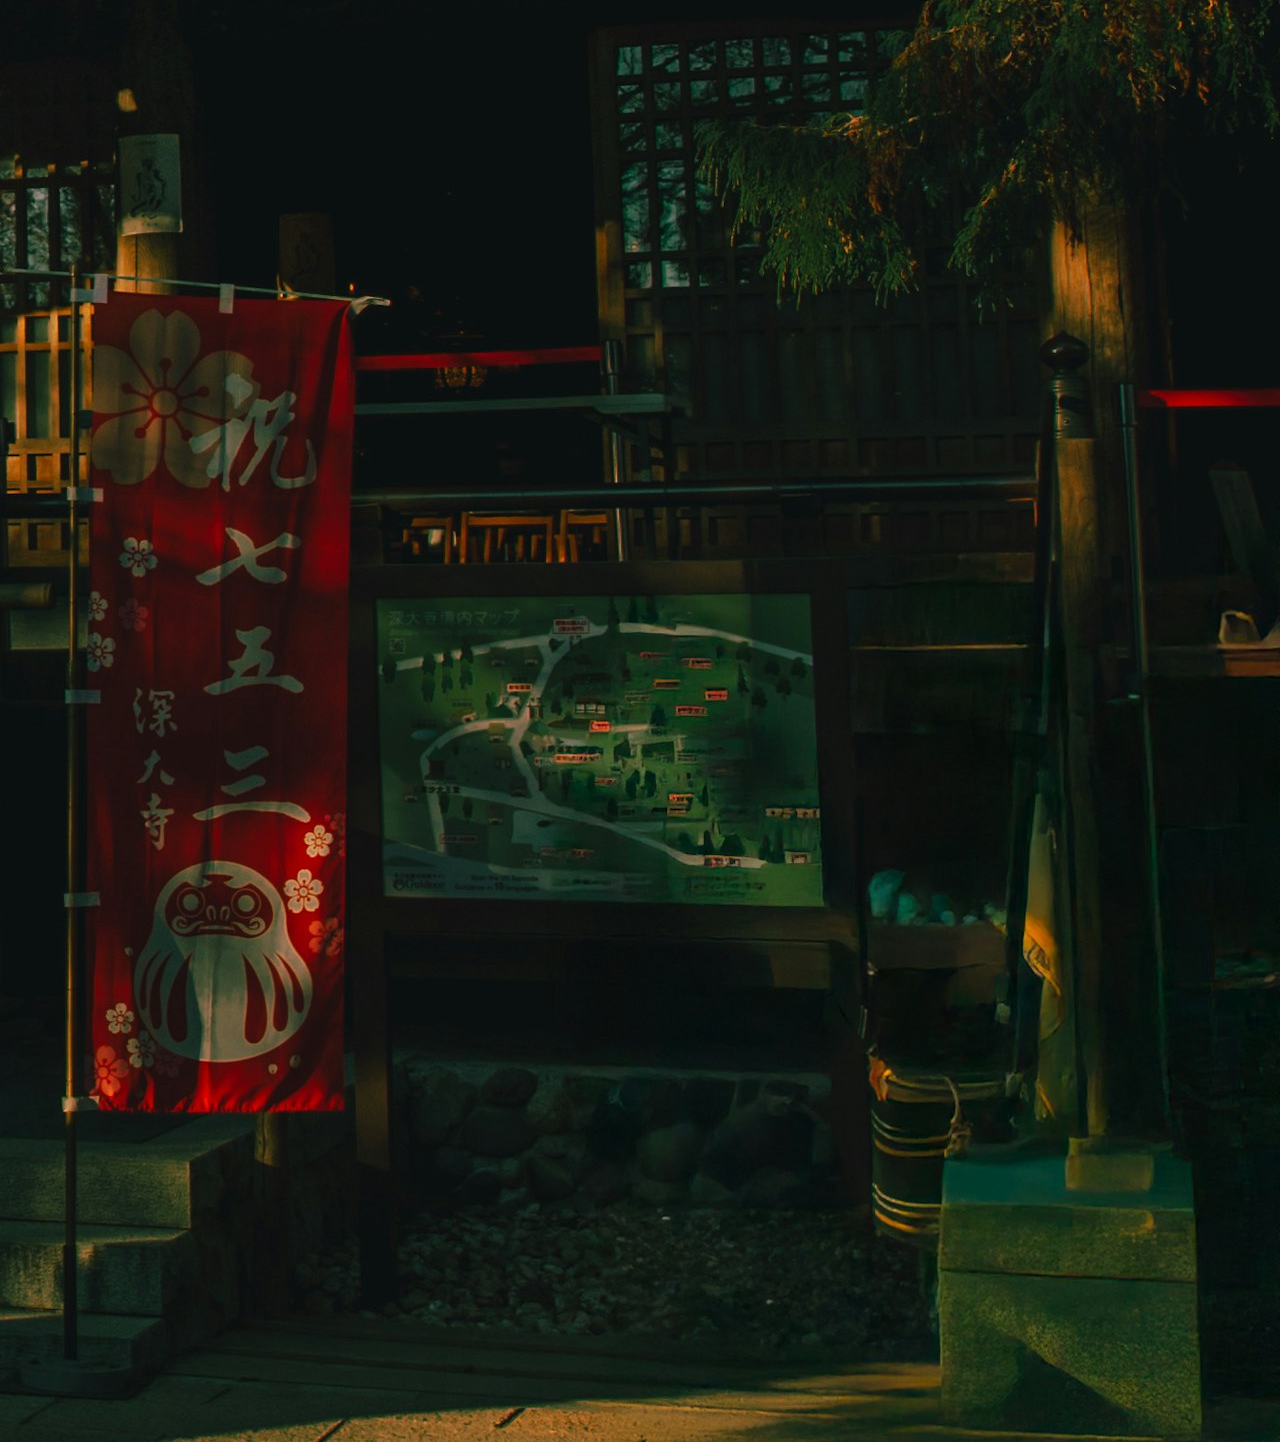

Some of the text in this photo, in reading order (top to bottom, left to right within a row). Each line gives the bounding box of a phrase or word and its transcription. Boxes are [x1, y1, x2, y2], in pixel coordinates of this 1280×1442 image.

[189, 371, 318, 825] 祝七五三
[131, 686, 179, 854] 深大寺
